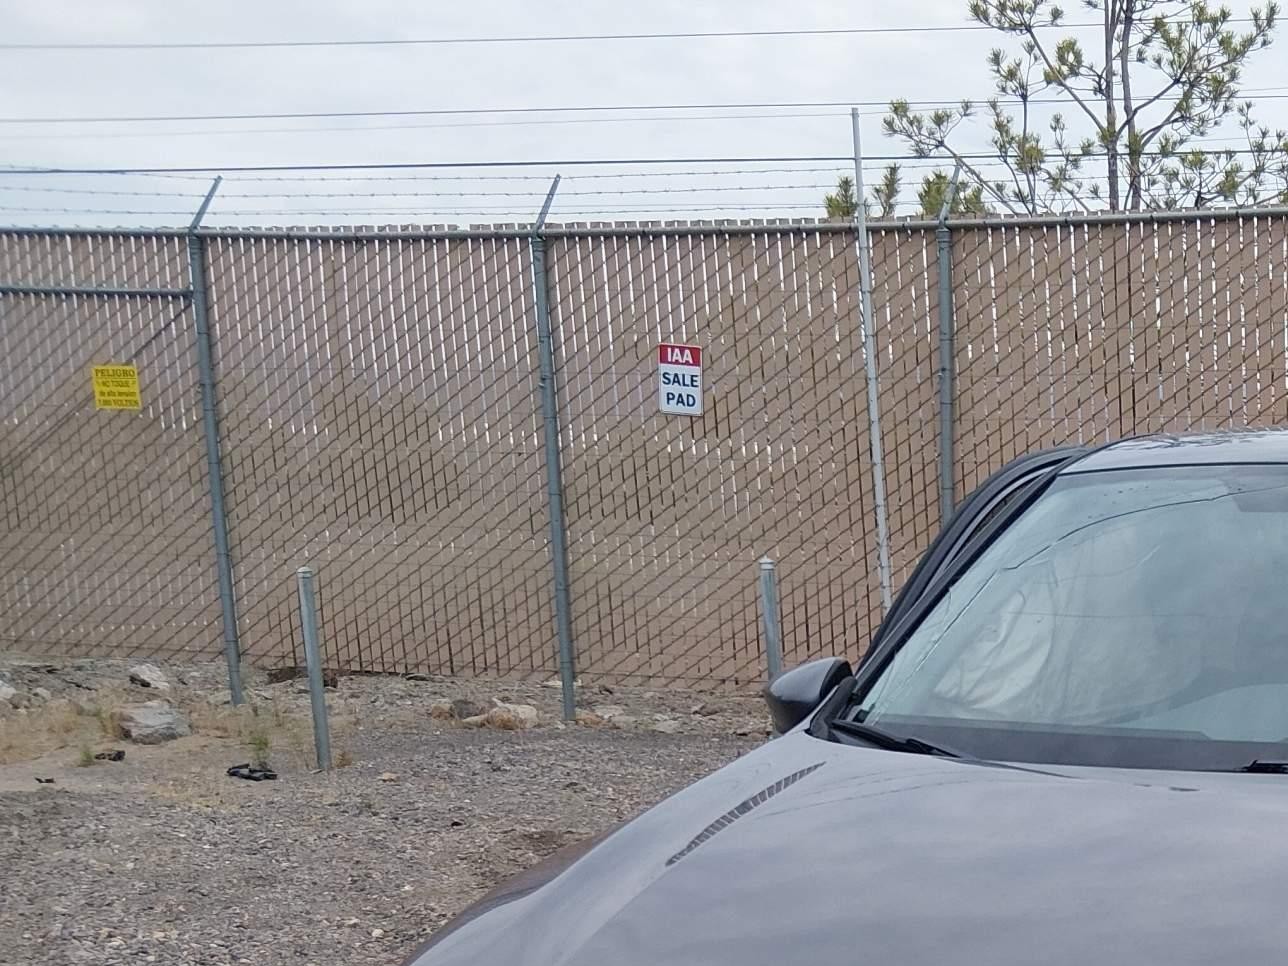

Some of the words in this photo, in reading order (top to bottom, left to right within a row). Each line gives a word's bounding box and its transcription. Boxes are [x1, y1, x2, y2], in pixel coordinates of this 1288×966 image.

[667, 347, 694, 364] IAA
[95, 368, 136, 378] PELIGRO
[661, 371, 700, 388] SALE
[666, 392, 697, 407] PAD
